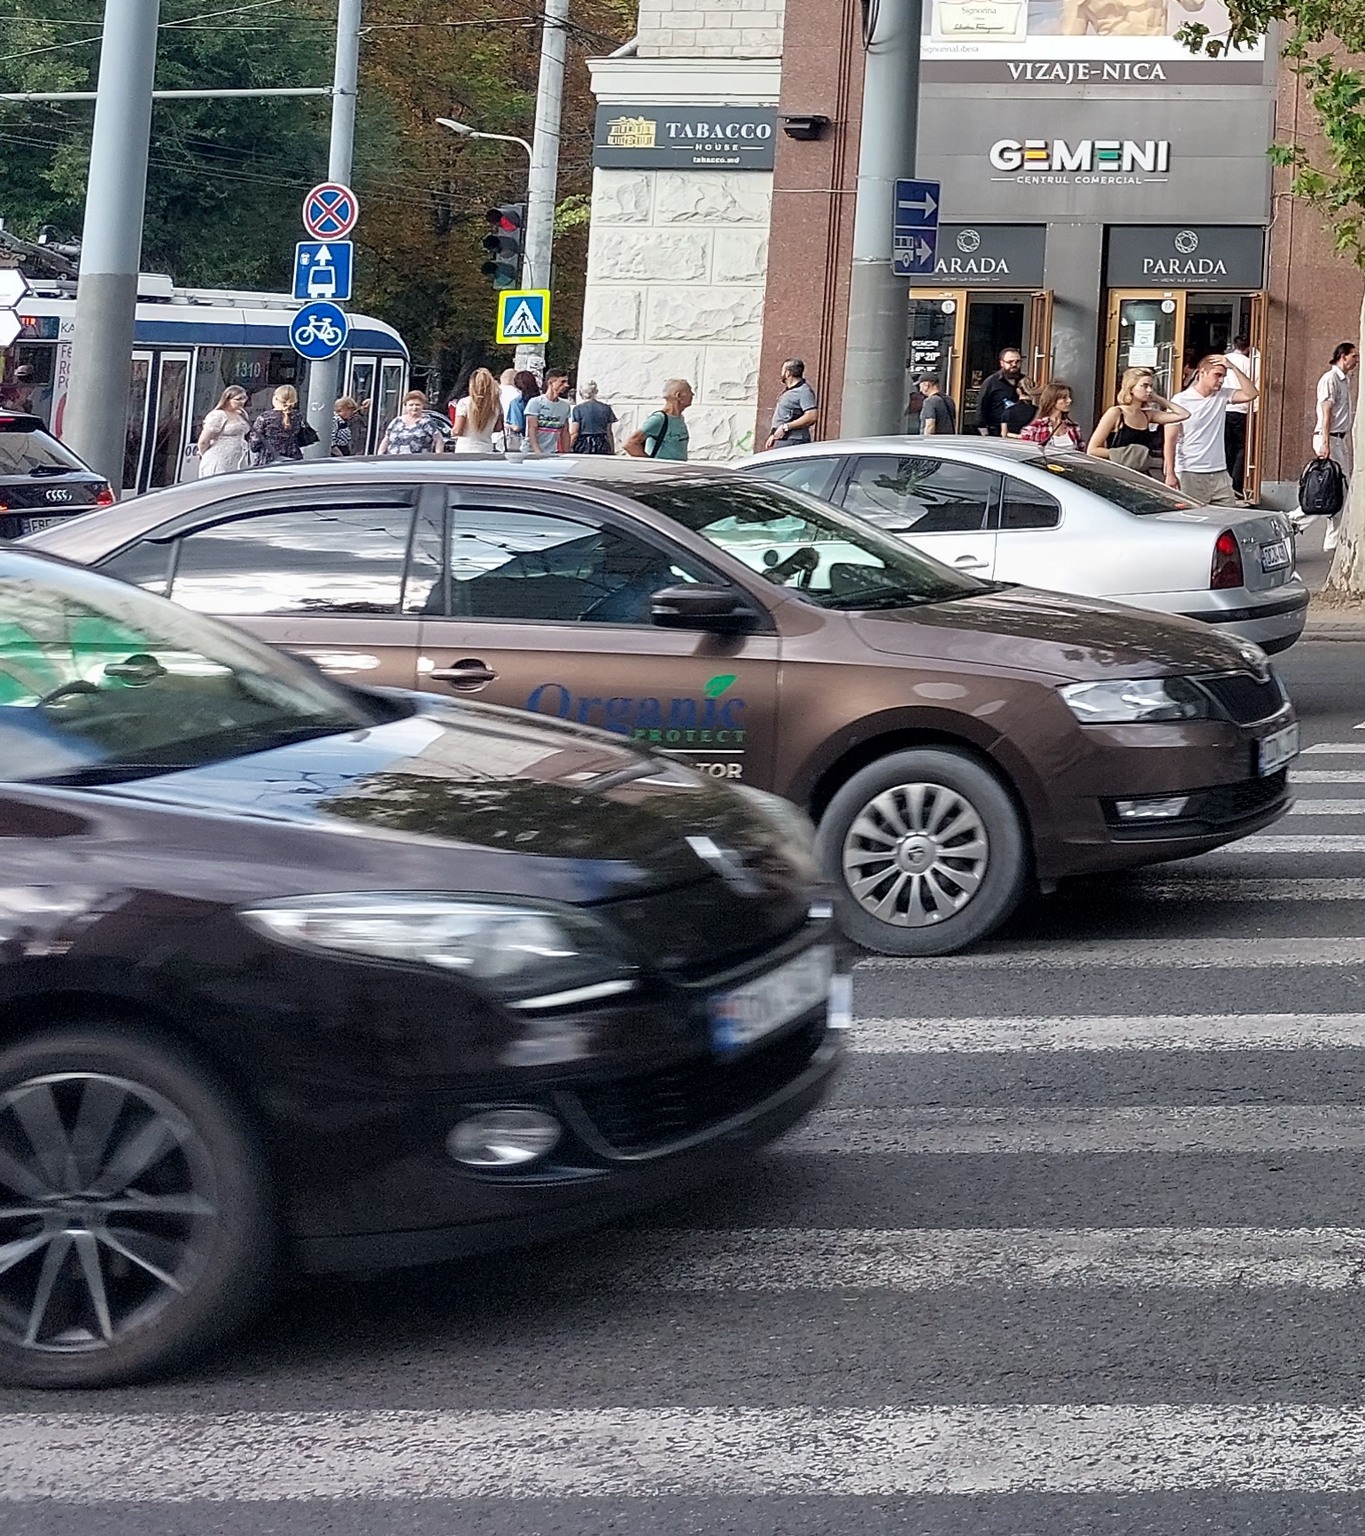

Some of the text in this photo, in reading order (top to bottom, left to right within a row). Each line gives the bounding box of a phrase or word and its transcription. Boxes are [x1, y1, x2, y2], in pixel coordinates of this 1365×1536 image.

[1006, 62, 1167, 84] VIZAJE-NICA
[665, 122, 772, 140] TABACCO
[694, 143, 739, 152] HOUSE
[989, 139, 1170, 173] GEMENI
[1016, 175, 1142, 185] CENTRUL COMERCIAL
[934, 258, 1010, 274] ARADA
[1143, 258, 1227, 275] PARADA
[235, 362, 261, 378] 1310
[526, 675, 746, 735] Organic
[631, 729, 747, 743] PROTECT
[696, 762, 744, 779] TOR
